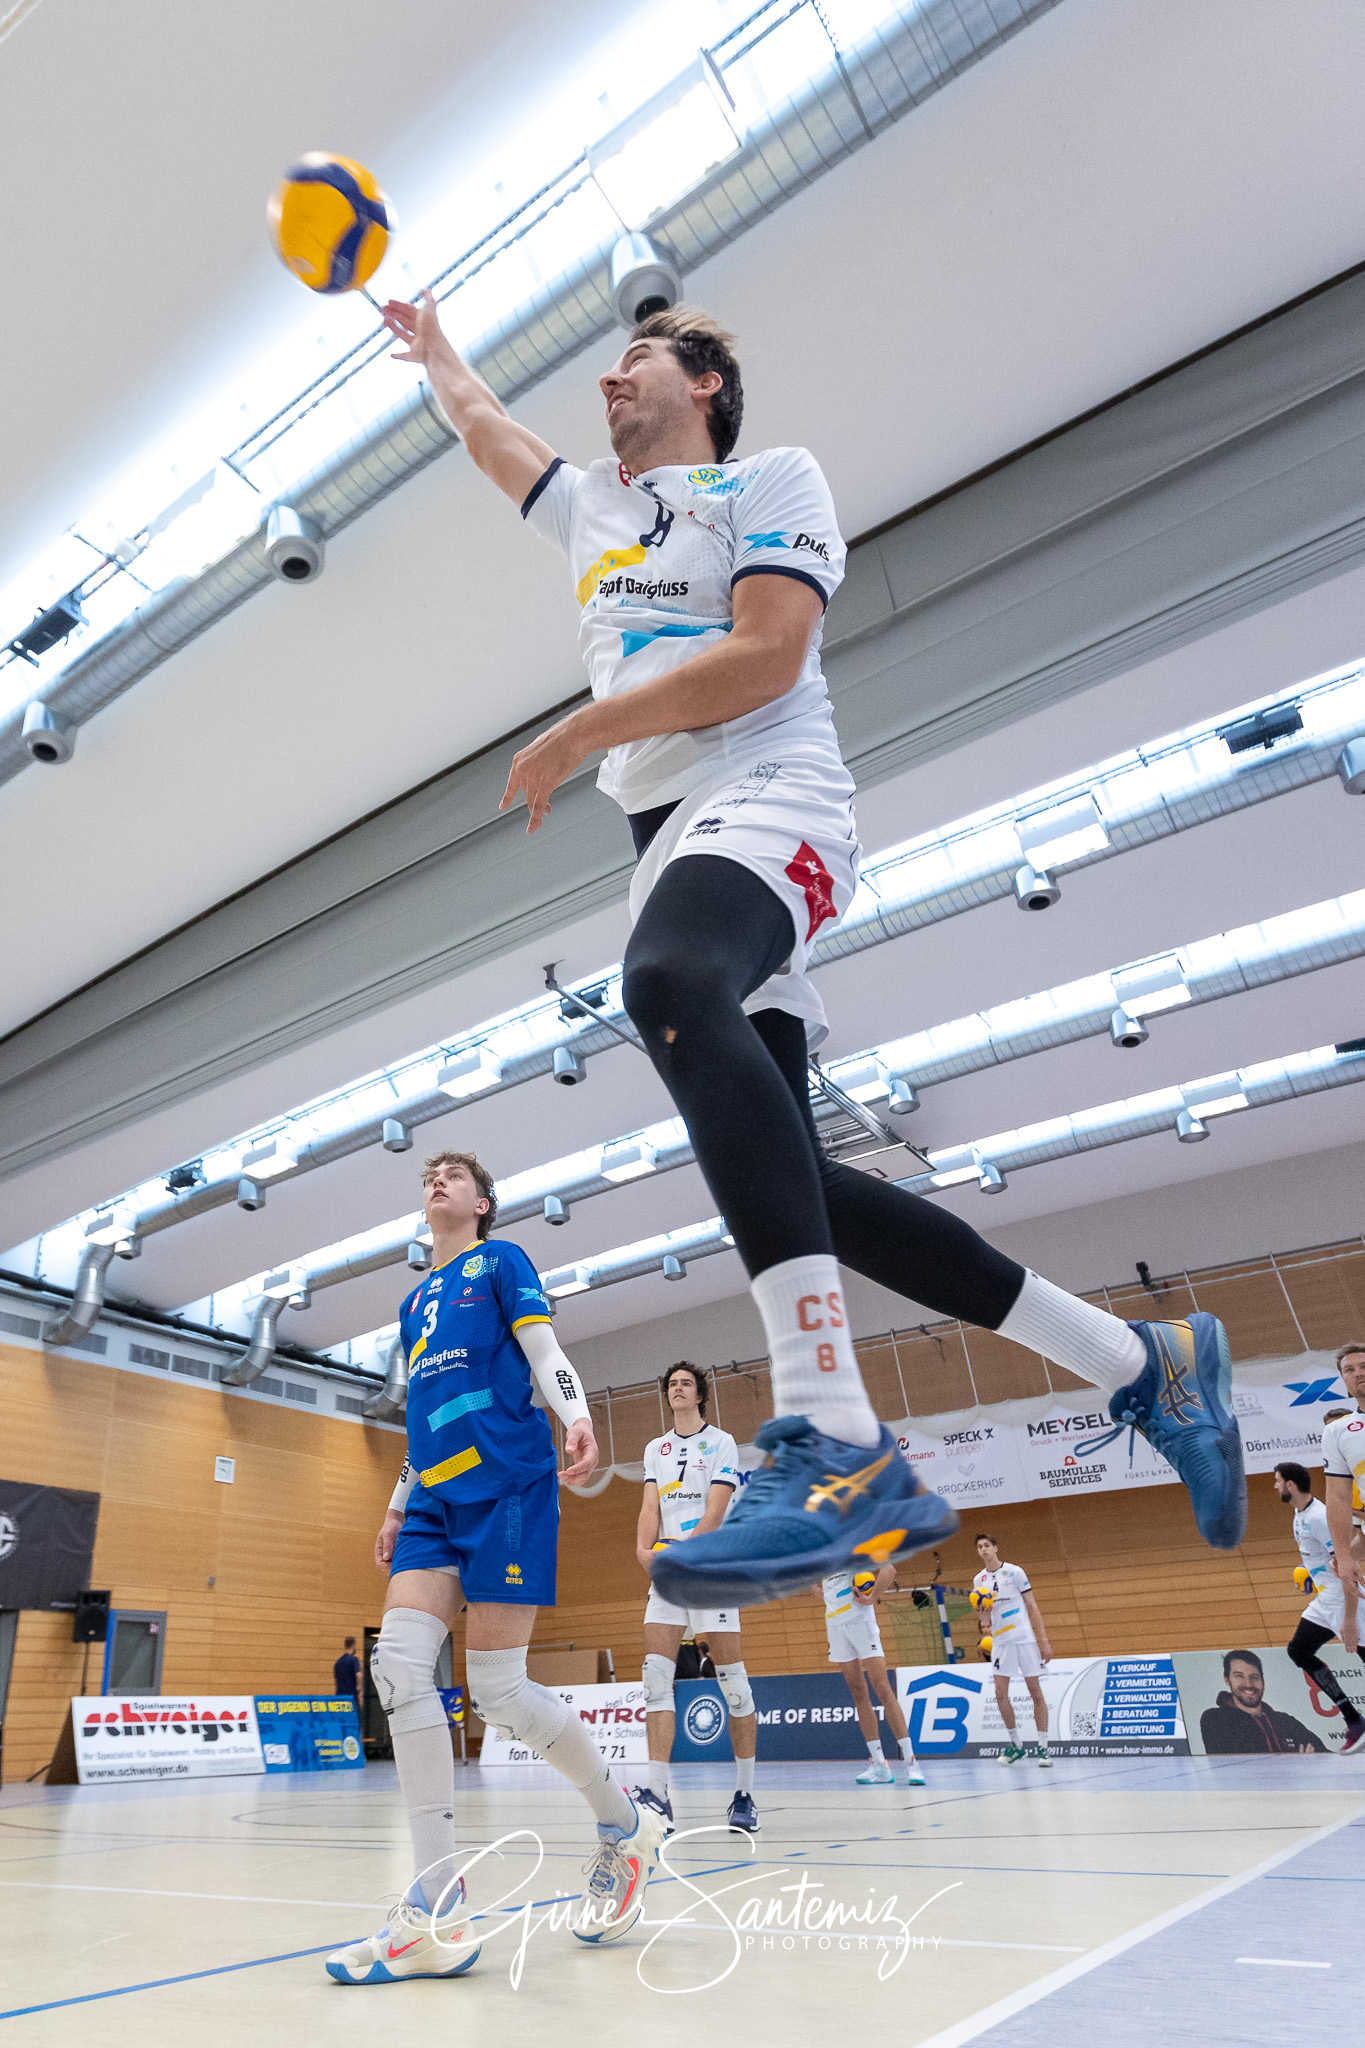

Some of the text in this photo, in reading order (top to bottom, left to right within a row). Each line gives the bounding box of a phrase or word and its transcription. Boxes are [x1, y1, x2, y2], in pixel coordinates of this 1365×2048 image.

[792, 533, 830, 562] puls
[599, 576, 689, 600] apf Daigfuss
[421, 1299, 440, 1338] 3
[796, 1291, 844, 1331] CS
[421, 1348, 468, 1369] Daigfuss
[816, 1343, 838, 1373] 8
[1027, 1413, 1112, 1437] MEYSEL
[943, 1430, 982, 1446] SPECK
[677, 1460, 687, 1482] 7
[1048, 1474, 1102, 1488] SERVICES
[1117, 1663, 1157, 1672] VERKAUF
[1116, 1677, 1171, 1687] VERMIETUNG
[1114, 1693, 1172, 1703] VERWALTUNG
[83, 1703, 248, 1742] schweiger
[754, 1705, 886, 1725] ME OF RESPT
[1112, 1709, 1159, 1718] BERATUNG
[1111, 1725, 1165, 1734] BEWERTUNG
[610, 1745, 626, 1759] 71
[1105, 1744, 1175, 1755] www.baur-immo.de
[85, 1764, 190, 1779] www.schweiger.de
